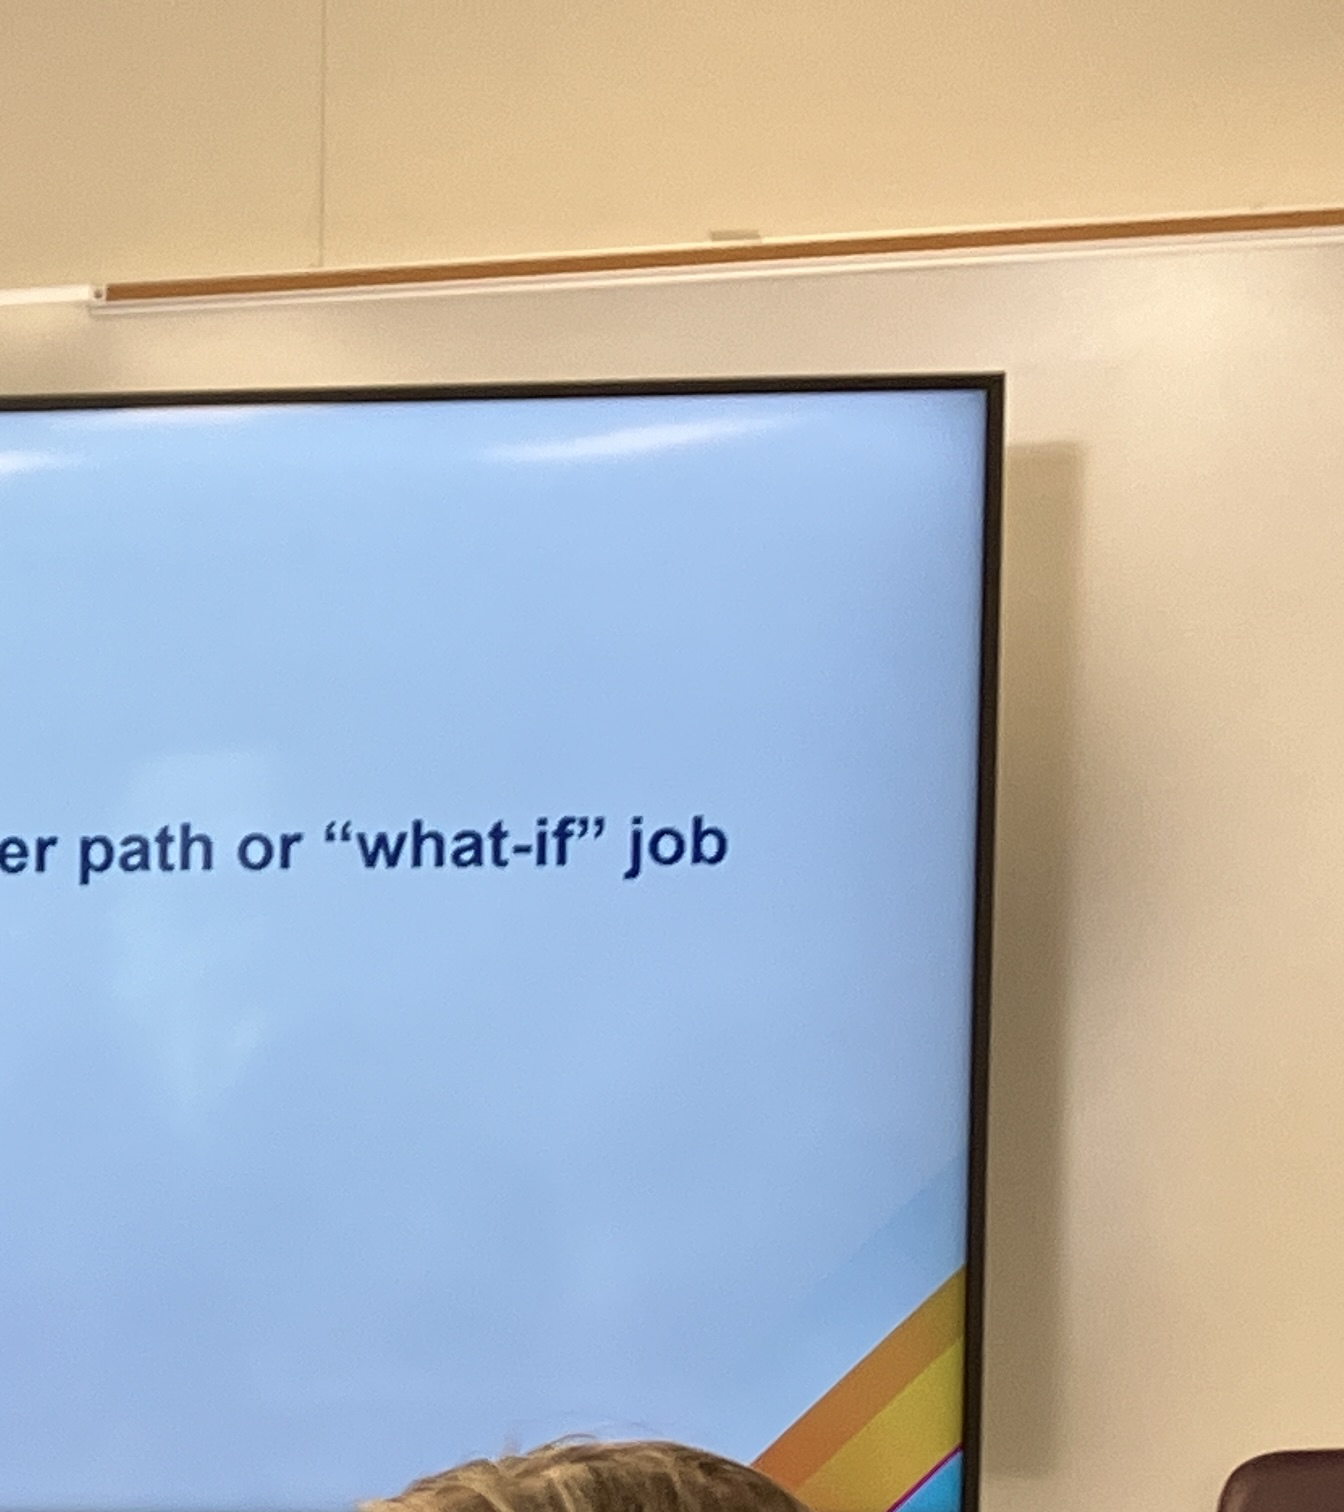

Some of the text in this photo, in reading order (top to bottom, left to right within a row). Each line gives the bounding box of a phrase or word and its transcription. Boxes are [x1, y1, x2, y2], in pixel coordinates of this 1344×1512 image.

[78, 821, 214, 887] path
[236, 831, 305, 874] or
[323, 814, 607, 871] “what-if”
[621, 813, 730, 882] job
